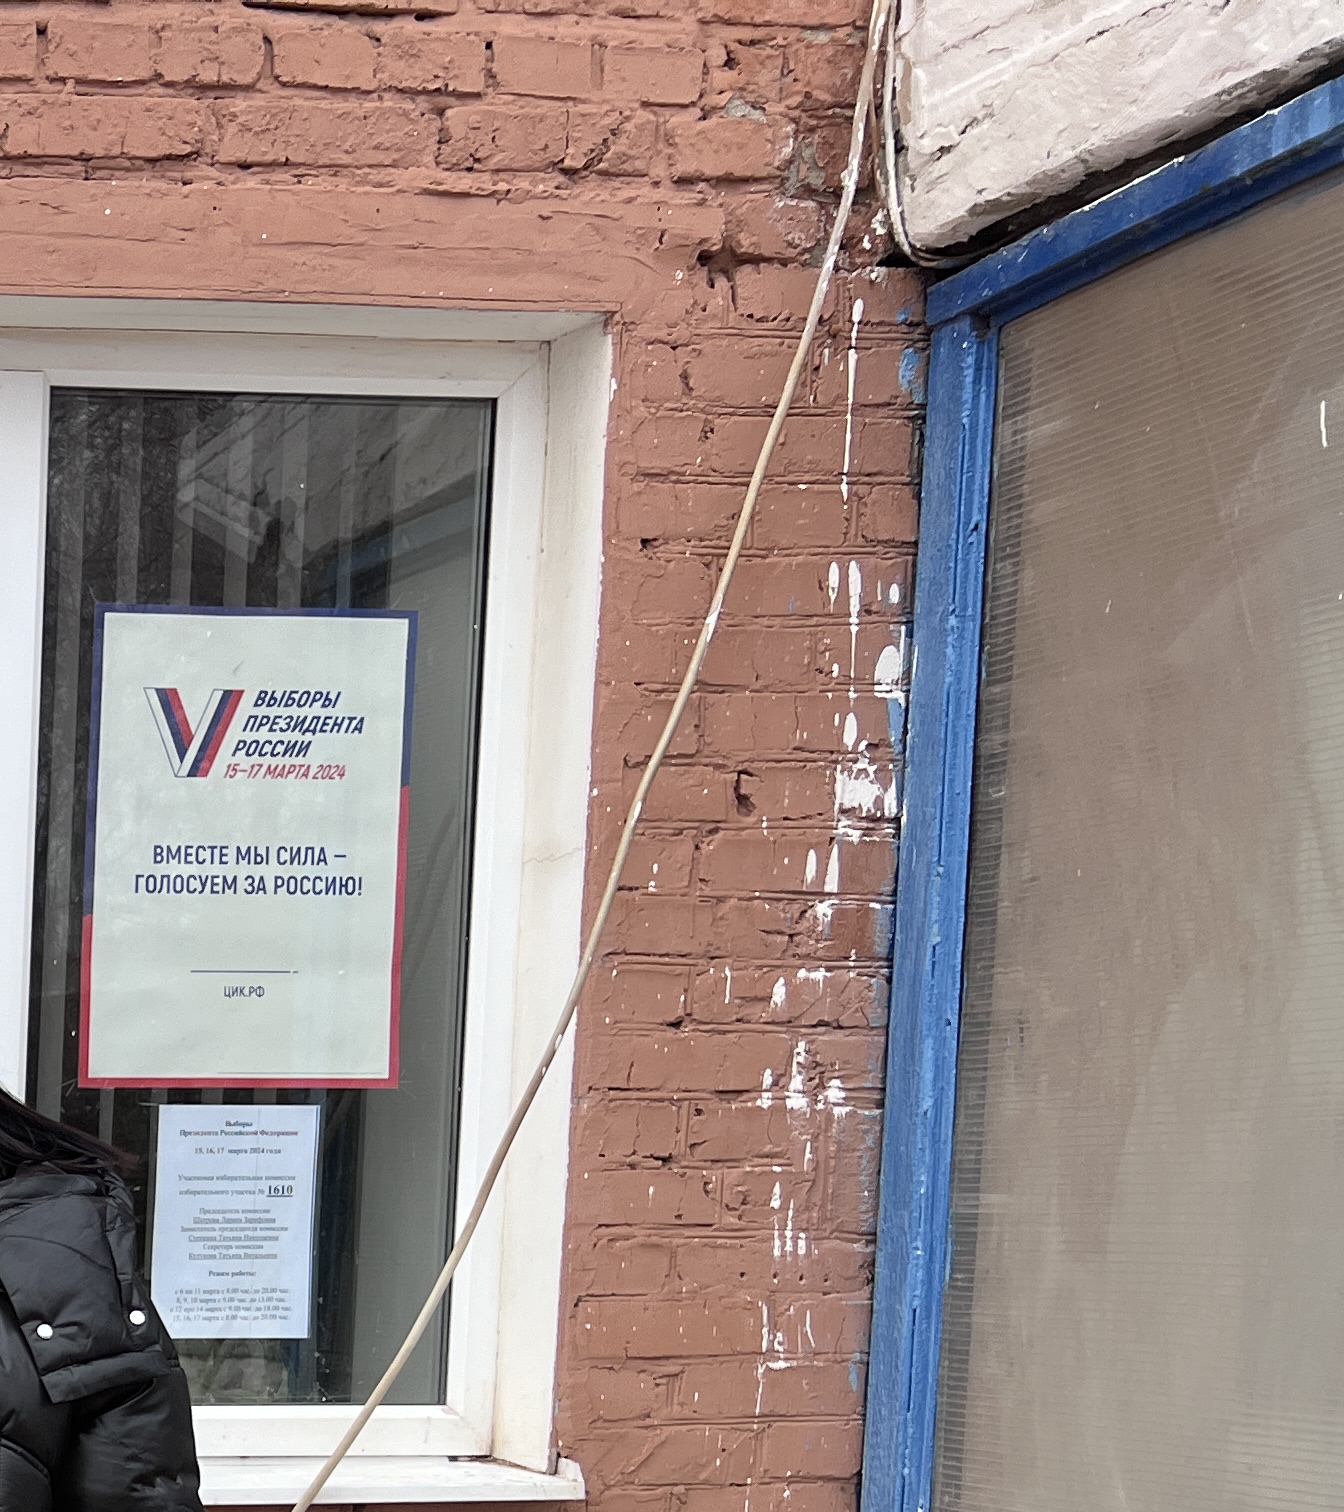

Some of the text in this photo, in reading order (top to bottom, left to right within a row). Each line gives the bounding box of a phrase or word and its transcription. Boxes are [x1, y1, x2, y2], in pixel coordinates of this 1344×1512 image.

[253, 690, 342, 709] ВЫБОРЫ
[242, 714, 365, 736] ПРЕЗИДЕНТА
[231, 739, 312, 758] РОССИИ
[262, 764, 311, 779] МАРТА
[312, 764, 346, 780] 2024
[153, 845, 229, 865] ВМЕСТЕ
[235, 846, 269, 865] МЫ
[276, 846, 328, 866] СИЛА
[134, 874, 362, 896] ГОЛОСУЕМ ЗА РОССИЮ!
[223, 985, 265, 998] ЦИК.РФ
[267, 1184, 293, 1195] 1610
